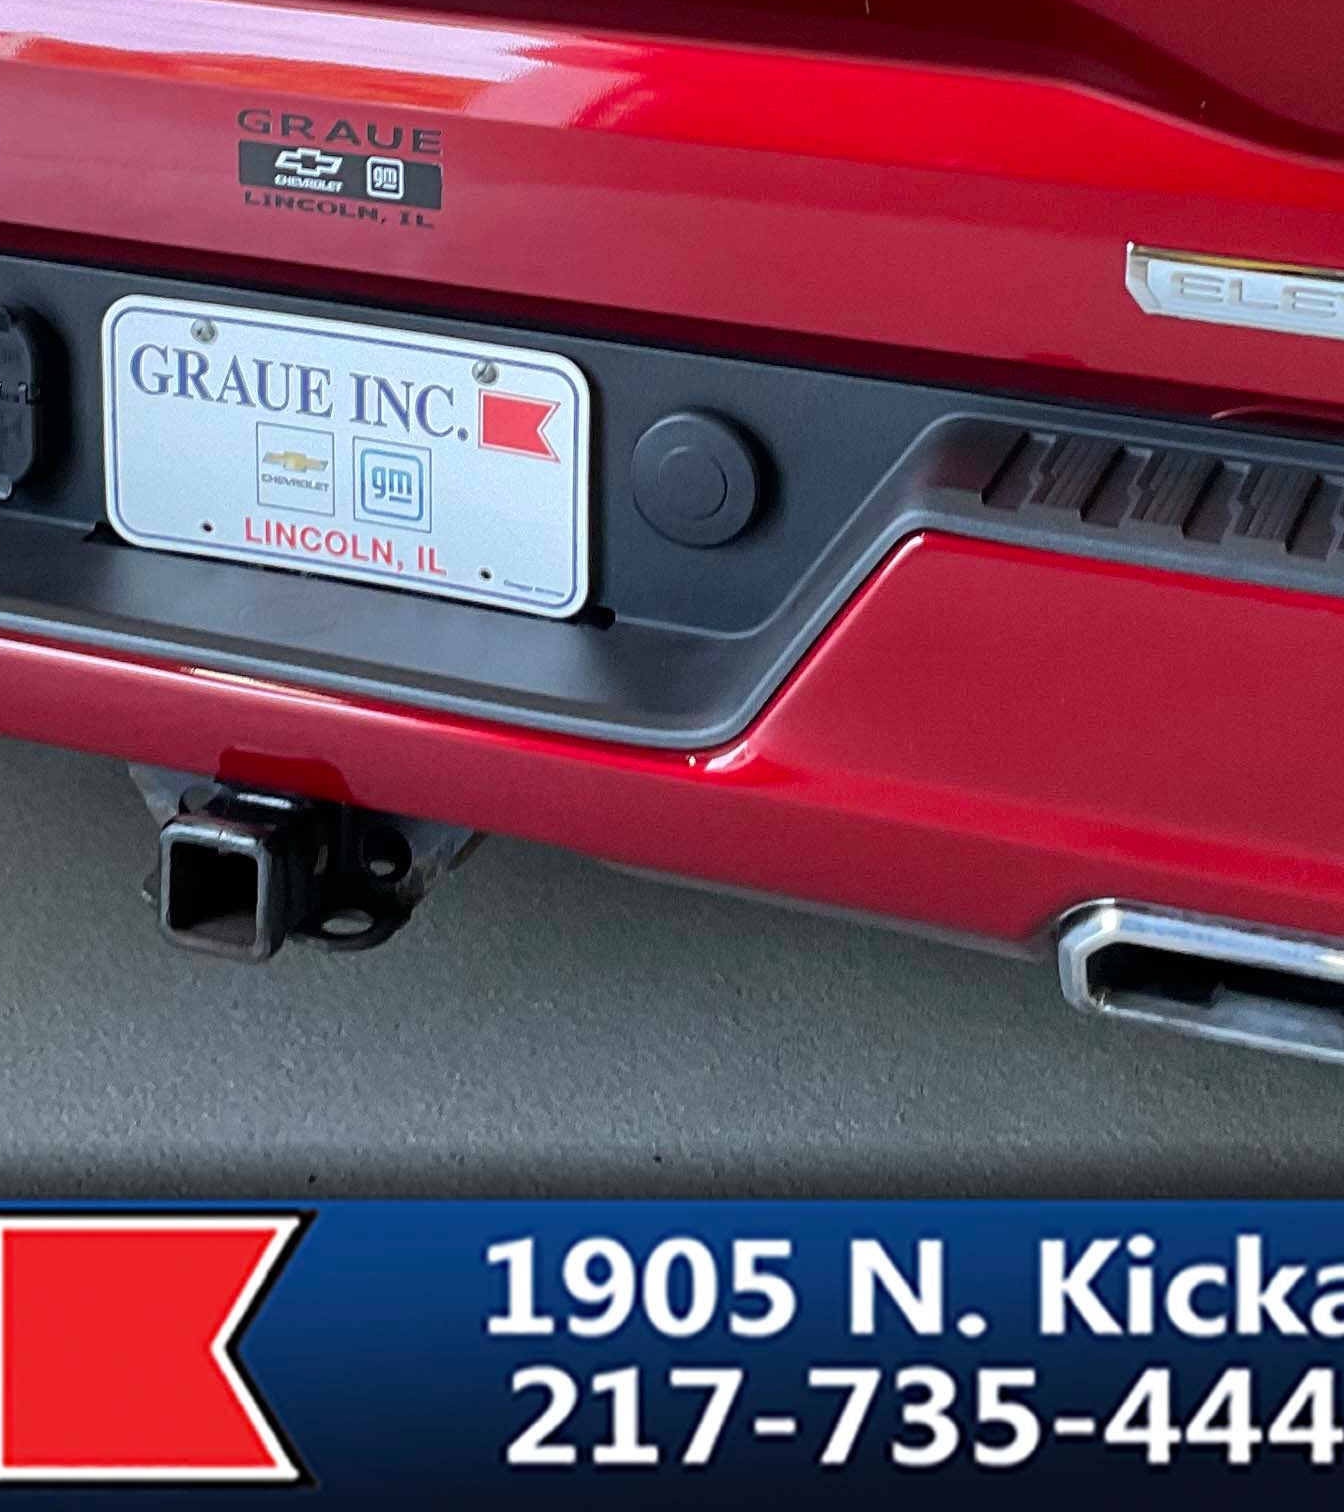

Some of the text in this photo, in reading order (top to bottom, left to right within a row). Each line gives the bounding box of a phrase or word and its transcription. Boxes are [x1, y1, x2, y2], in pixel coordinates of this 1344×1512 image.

[237, 108, 443, 155] GRAUE
[274, 173, 344, 193] CHEVROLET
[372, 165, 398, 190] gm
[244, 191, 435, 229] LINCOLN, IL
[129, 343, 470, 443] GRAUE INC.
[260, 473, 331, 493] CHEVROLET
[371, 465, 413, 505] gm
[244, 517, 448, 576] LINCOLN, IL
